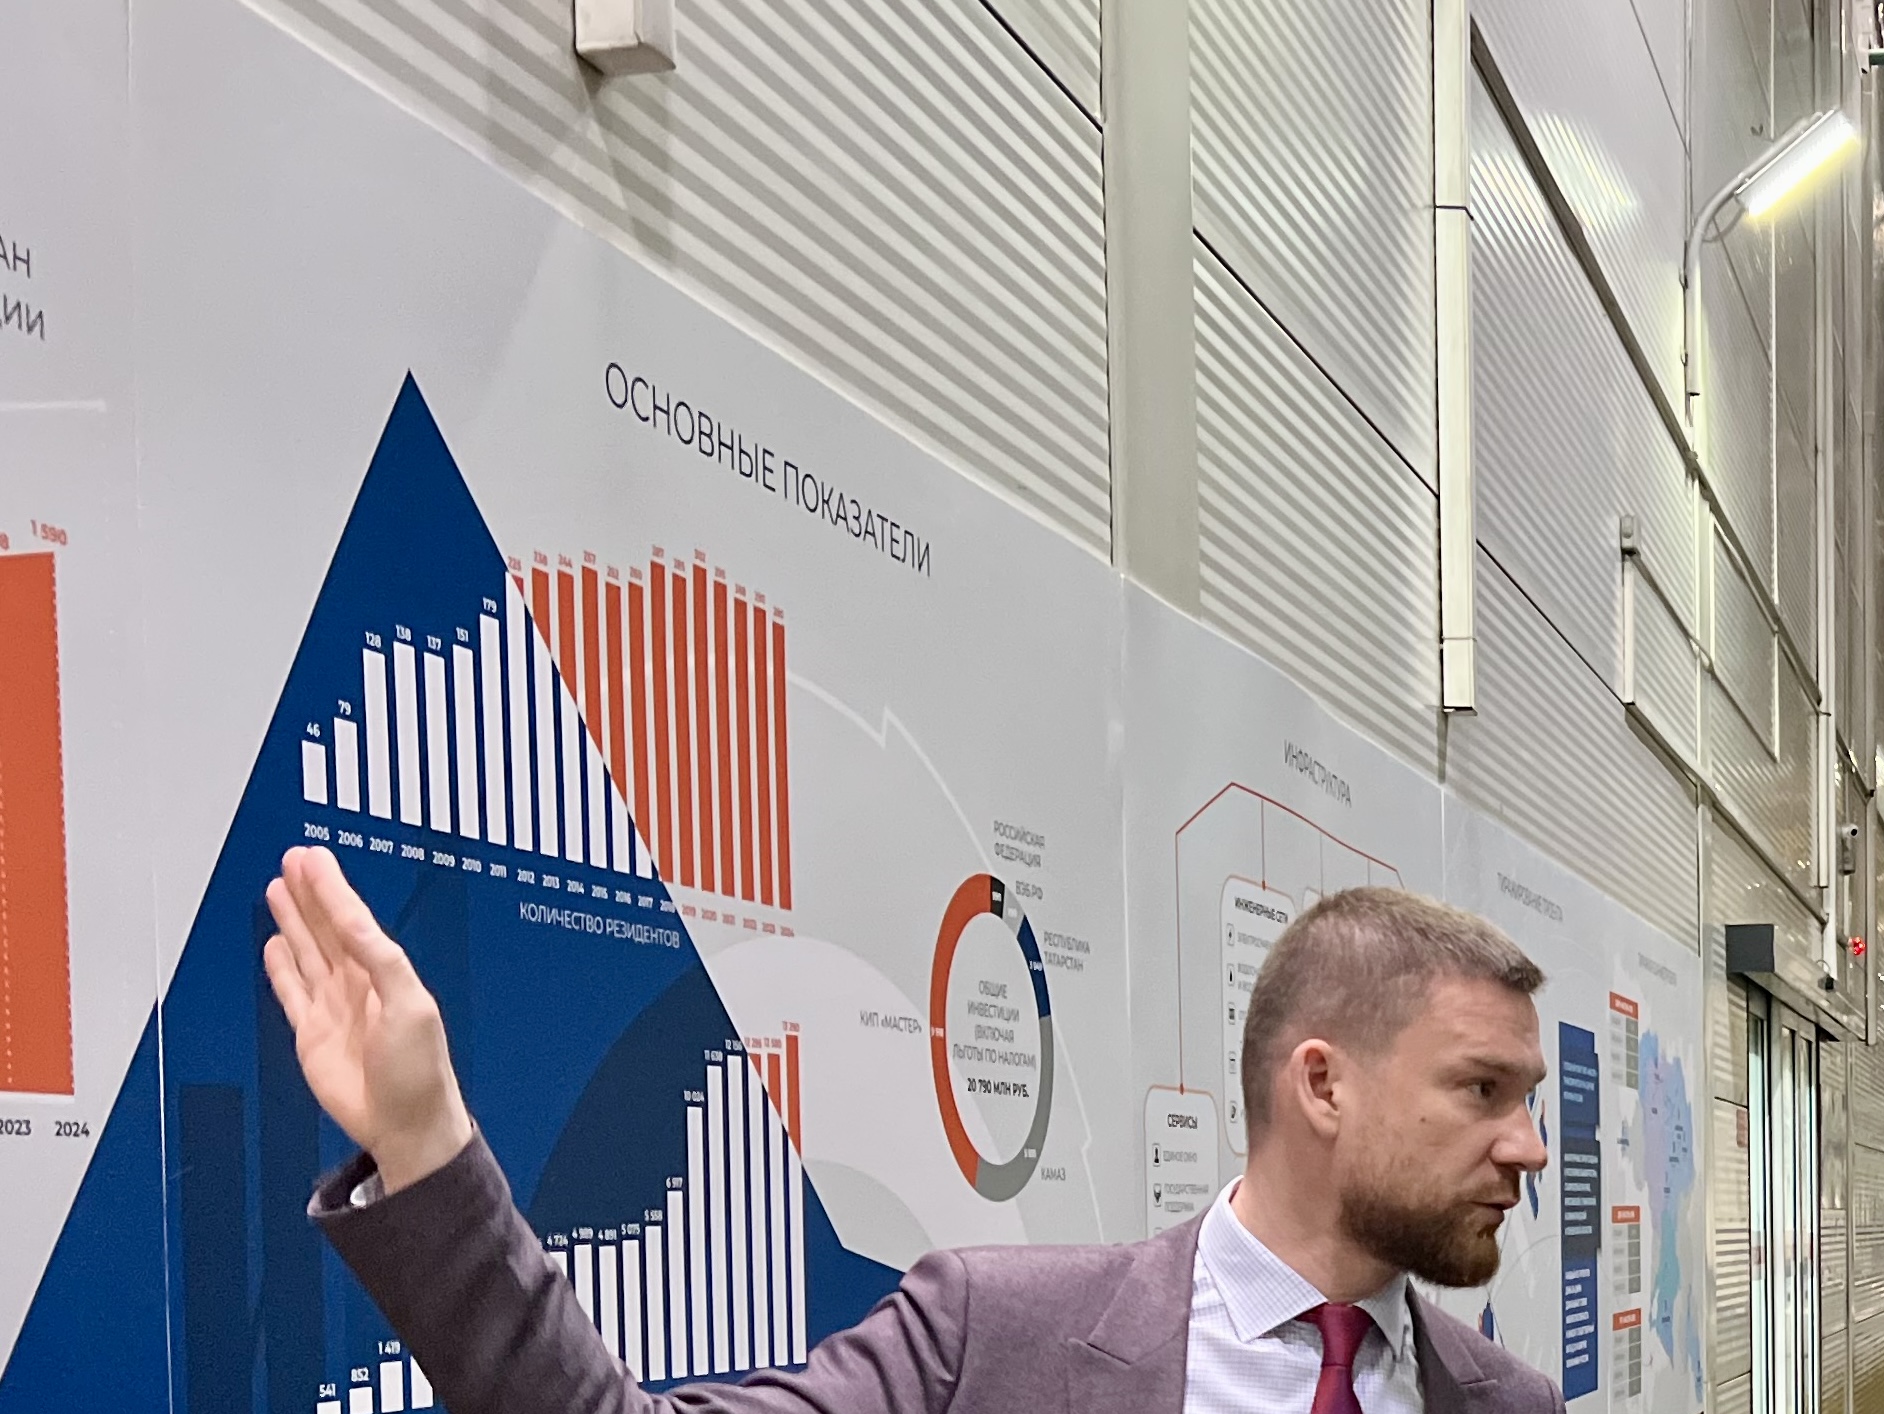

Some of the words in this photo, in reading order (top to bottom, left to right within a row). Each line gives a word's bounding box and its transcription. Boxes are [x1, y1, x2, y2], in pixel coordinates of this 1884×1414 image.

[0, 293, 45, 341] ИИ
[605, 362, 776, 493] ОСНОВНЫЕ
[783, 460, 931, 578] ПОКАЗАТЕЛИ
[482, 596, 497, 613] 179
[365, 631, 382, 649] 128
[426, 634, 442, 651] 137
[455, 626, 469, 643] 151
[337, 699, 352, 715] 79
[306, 722, 321, 738] 46
[1284, 739, 1352, 808] ИНФРАСТРУКТУРА
[993, 820, 1045, 849] РОССИЙСКАЯ
[304, 822, 330, 841] 2005
[337, 829, 364, 848] 2006
[369, 836, 394, 855] 2007
[401, 844, 425, 861] 2008
[432, 851, 456, 868] 2009
[462, 857, 482, 873] 2010
[489, 863, 507, 878] 2011
[517, 868, 535, 885] 2012
[542, 874, 560, 889] 2013
[566, 879, 585, 895] 2014
[591, 884, 609, 900] 2015
[994, 842, 1042, 868] ФЕДЕРАЦИЯ
[519, 901, 604, 935] КОЛИЧЕСТВО
[606, 918, 680, 949] РЕЗИДЕНТОВ
[1043, 931, 1091, 954] РЕСПУБЛИКА
[1043, 950, 1084, 972] ТАТАРСТАН
[993, 1081, 1012, 1096] МЛН
[55, 1120, 90, 1138] 2024
[1041, 1167, 1066, 1181] КАМАЗ
[351, 1367, 370, 1382] 852
[319, 1383, 336, 1398] 541
